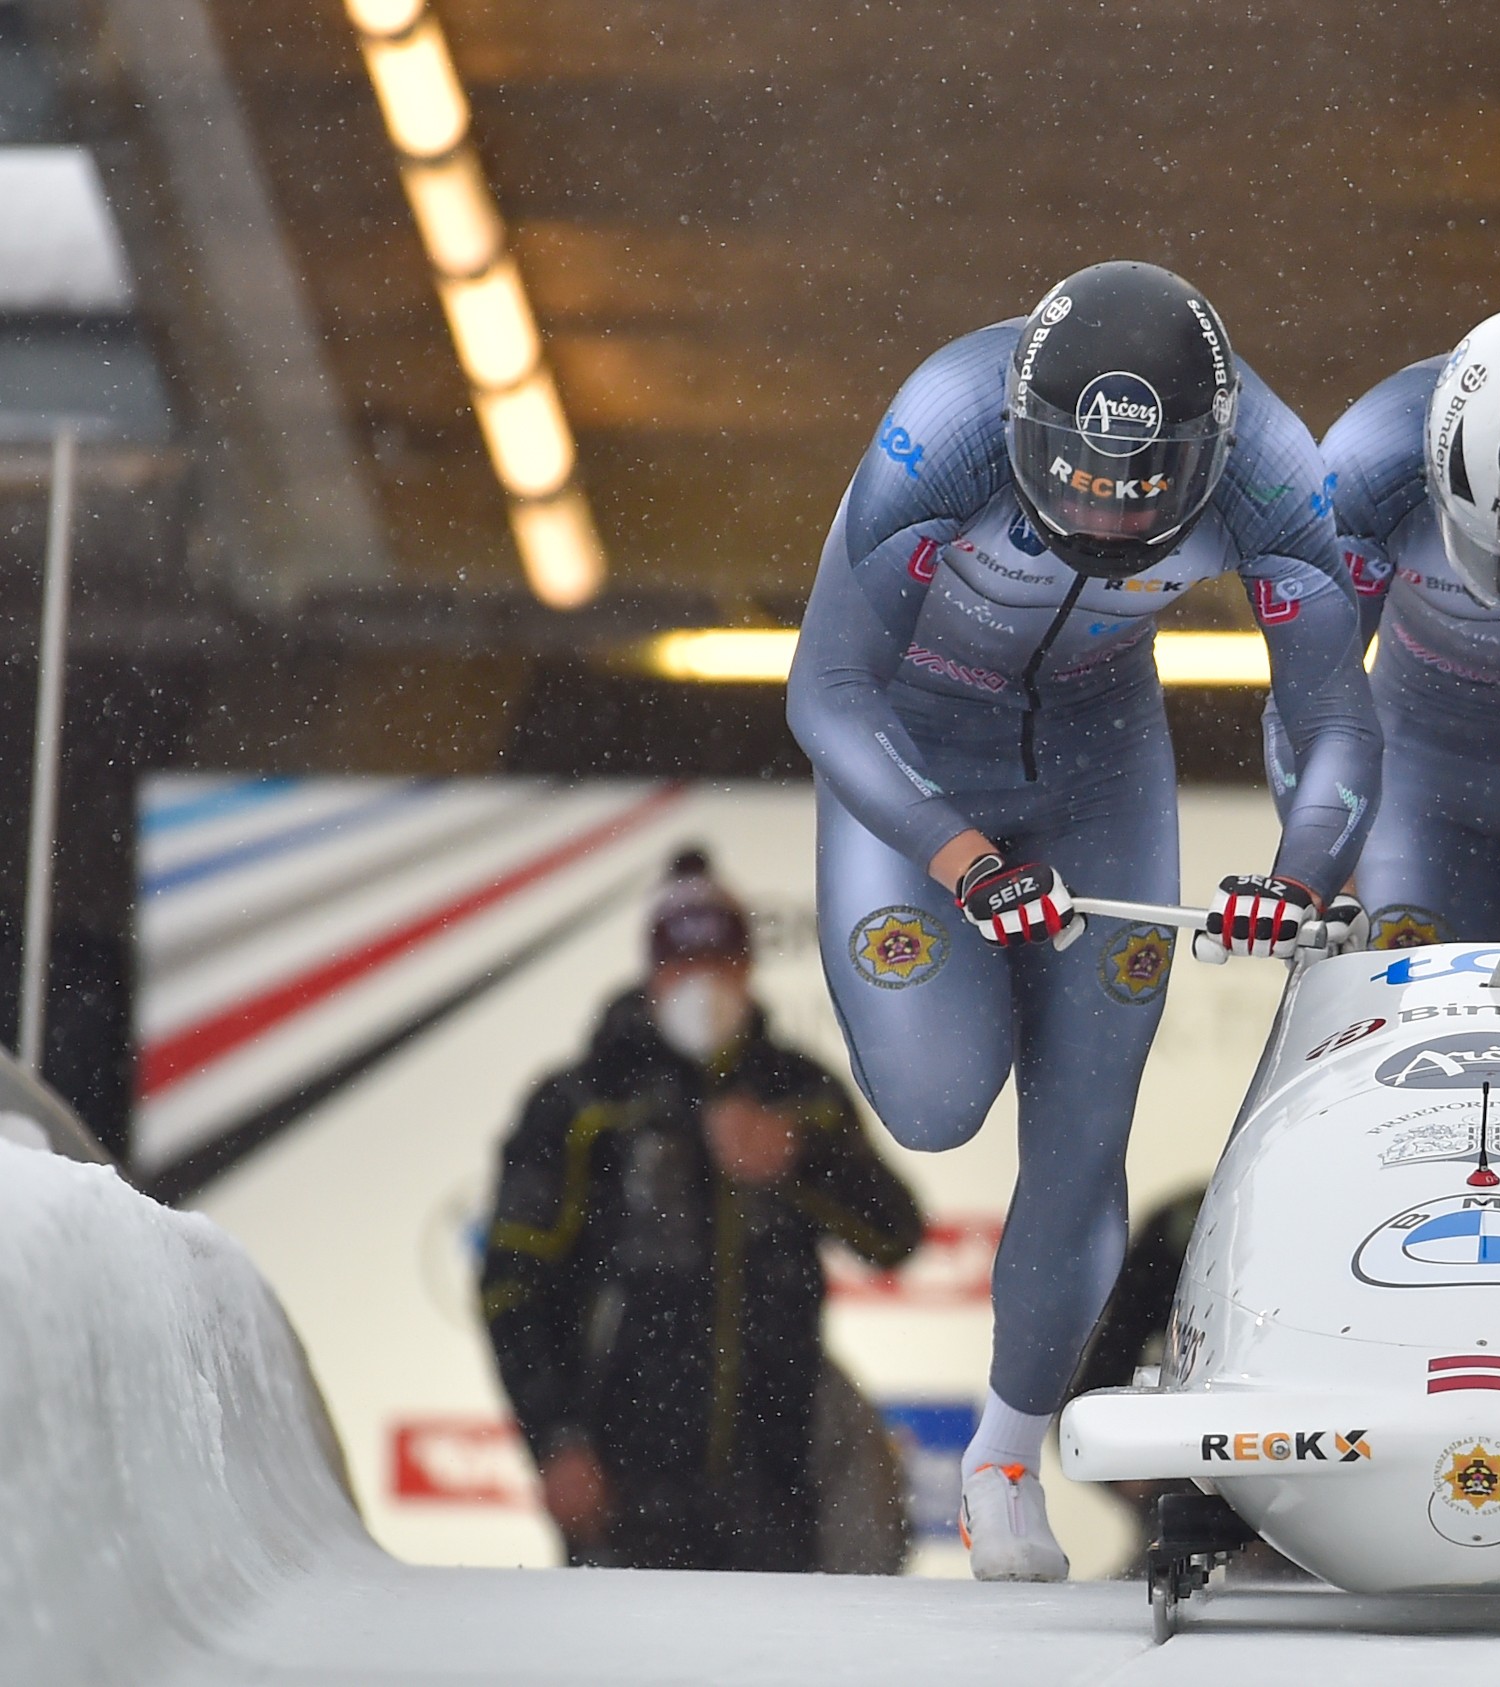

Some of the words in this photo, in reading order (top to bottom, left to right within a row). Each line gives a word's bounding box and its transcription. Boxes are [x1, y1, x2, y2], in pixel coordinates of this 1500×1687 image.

[1187, 299, 1228, 386] Binders
[1016, 327, 1051, 418] Binders
[1436, 395, 1467, 484] Binder
[1050, 456, 1140, 499] RECK
[975, 551, 1055, 586] Binders
[988, 877, 1036, 910] SEIZ
[1236, 876, 1288, 897] SEIZ
[1202, 1431, 1328, 1461] RECK
